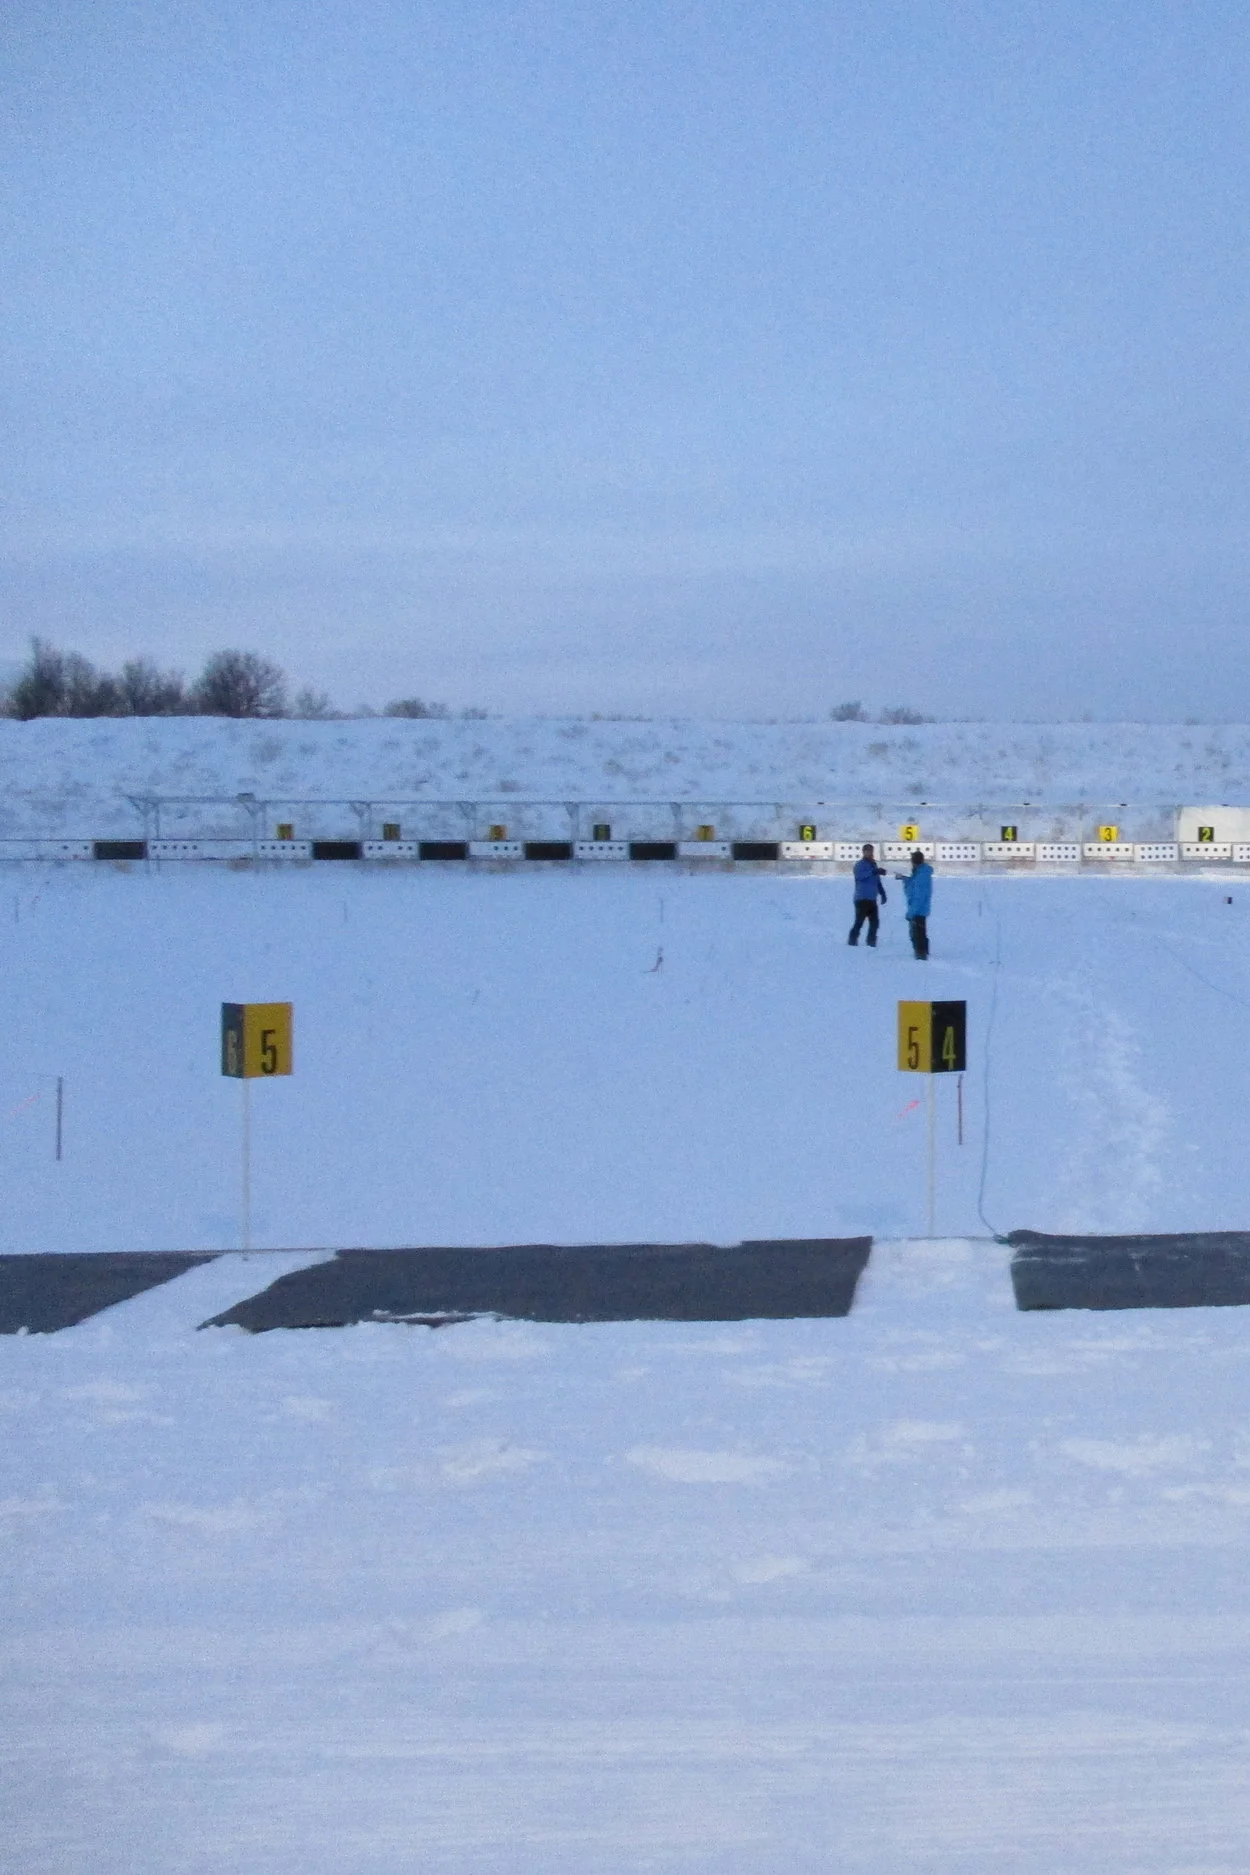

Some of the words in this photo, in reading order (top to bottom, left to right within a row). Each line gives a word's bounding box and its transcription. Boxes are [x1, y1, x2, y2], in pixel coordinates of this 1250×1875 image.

[803, 825, 813, 841] 6
[905, 826, 913, 841] 5
[1004, 826, 1013, 841] 4
[1104, 827, 1112, 841] 3
[1202, 827, 1211, 842] 2
[261, 1028, 277, 1075] 5
[907, 1026, 919, 1070] 5
[942, 1025, 957, 1071] 4
